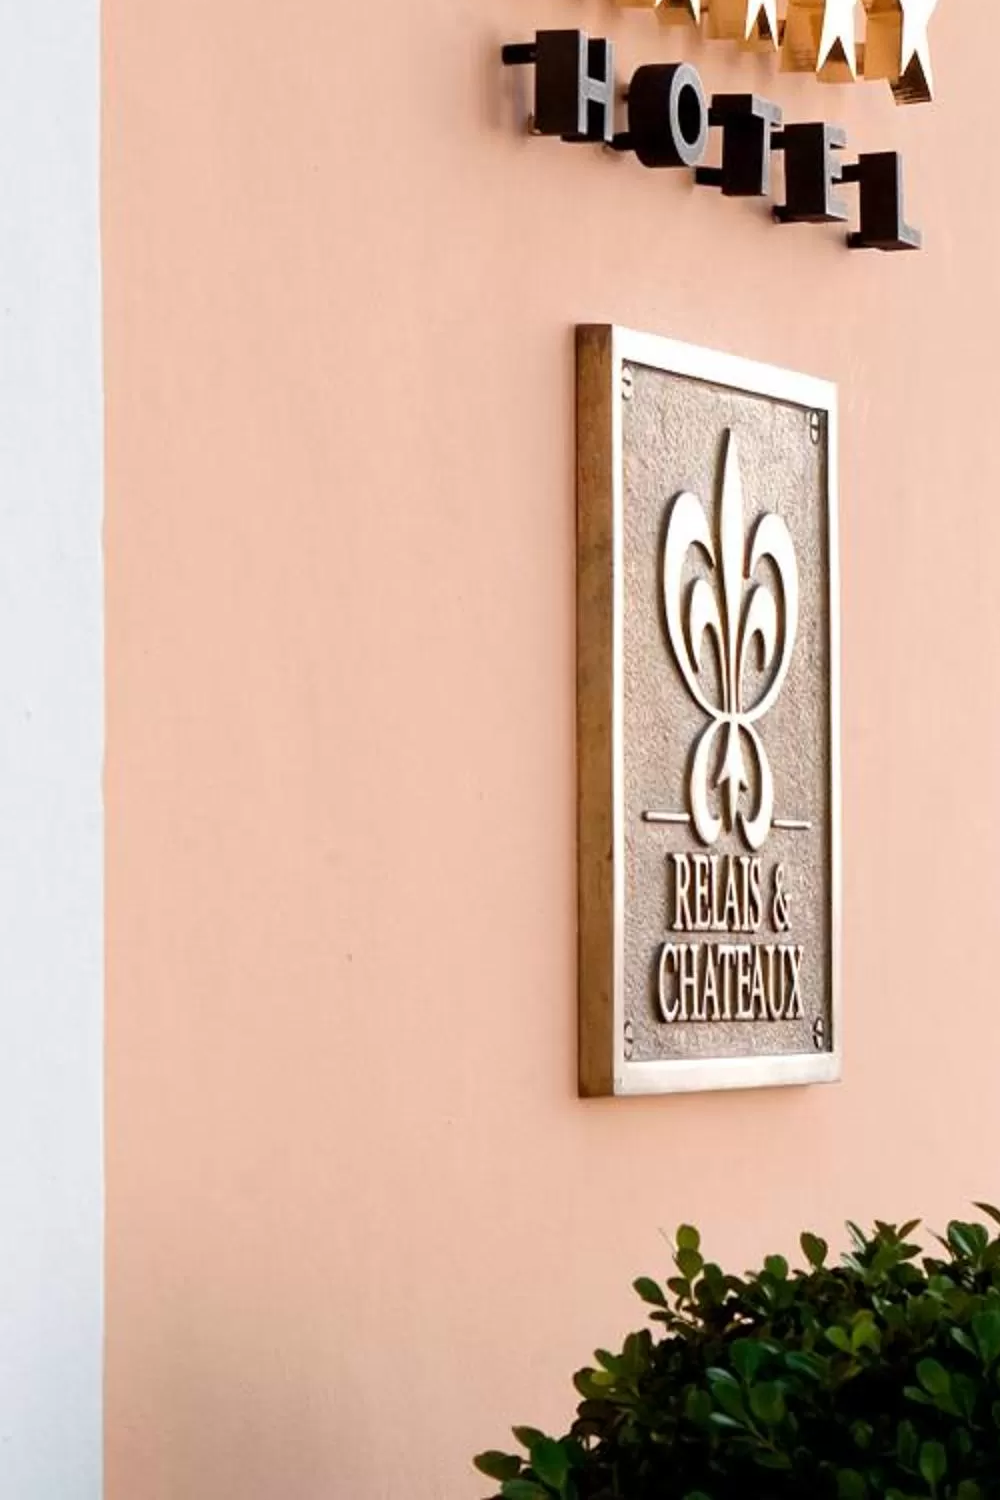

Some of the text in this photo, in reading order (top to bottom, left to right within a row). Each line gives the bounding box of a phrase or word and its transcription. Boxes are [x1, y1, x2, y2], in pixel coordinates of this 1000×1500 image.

[535, 29, 922, 251] HOTEL
[669, 852, 793, 932] RELAIS &
[656, 942, 805, 1023] CHATEAUX
